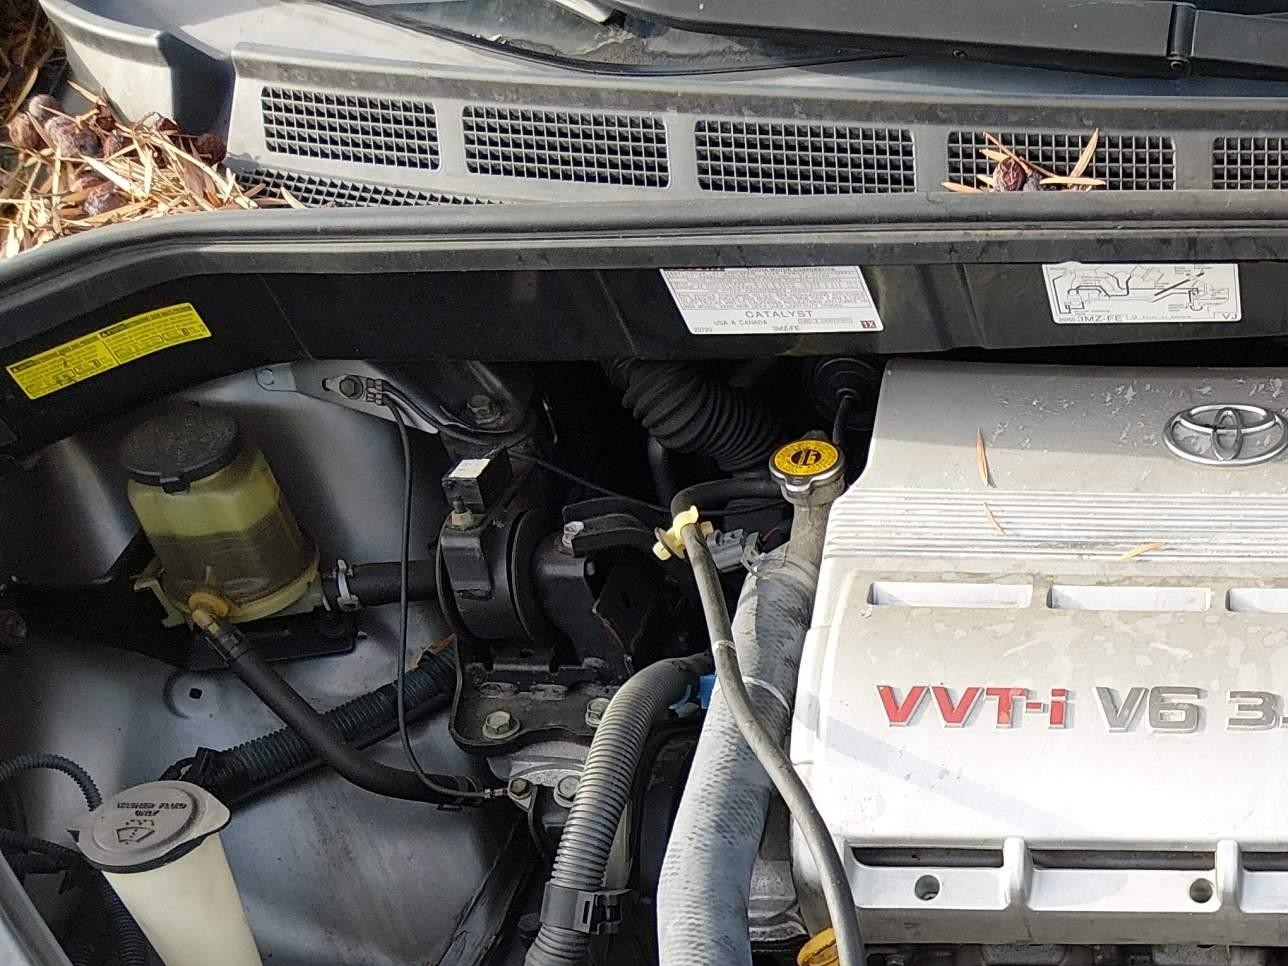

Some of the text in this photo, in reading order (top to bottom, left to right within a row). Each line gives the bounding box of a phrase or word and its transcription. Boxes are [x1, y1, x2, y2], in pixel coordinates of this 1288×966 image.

[745, 310, 813, 318] CATALYST
[876, 684, 1074, 729] VVT-i
[1092, 685, 1203, 734] V6
